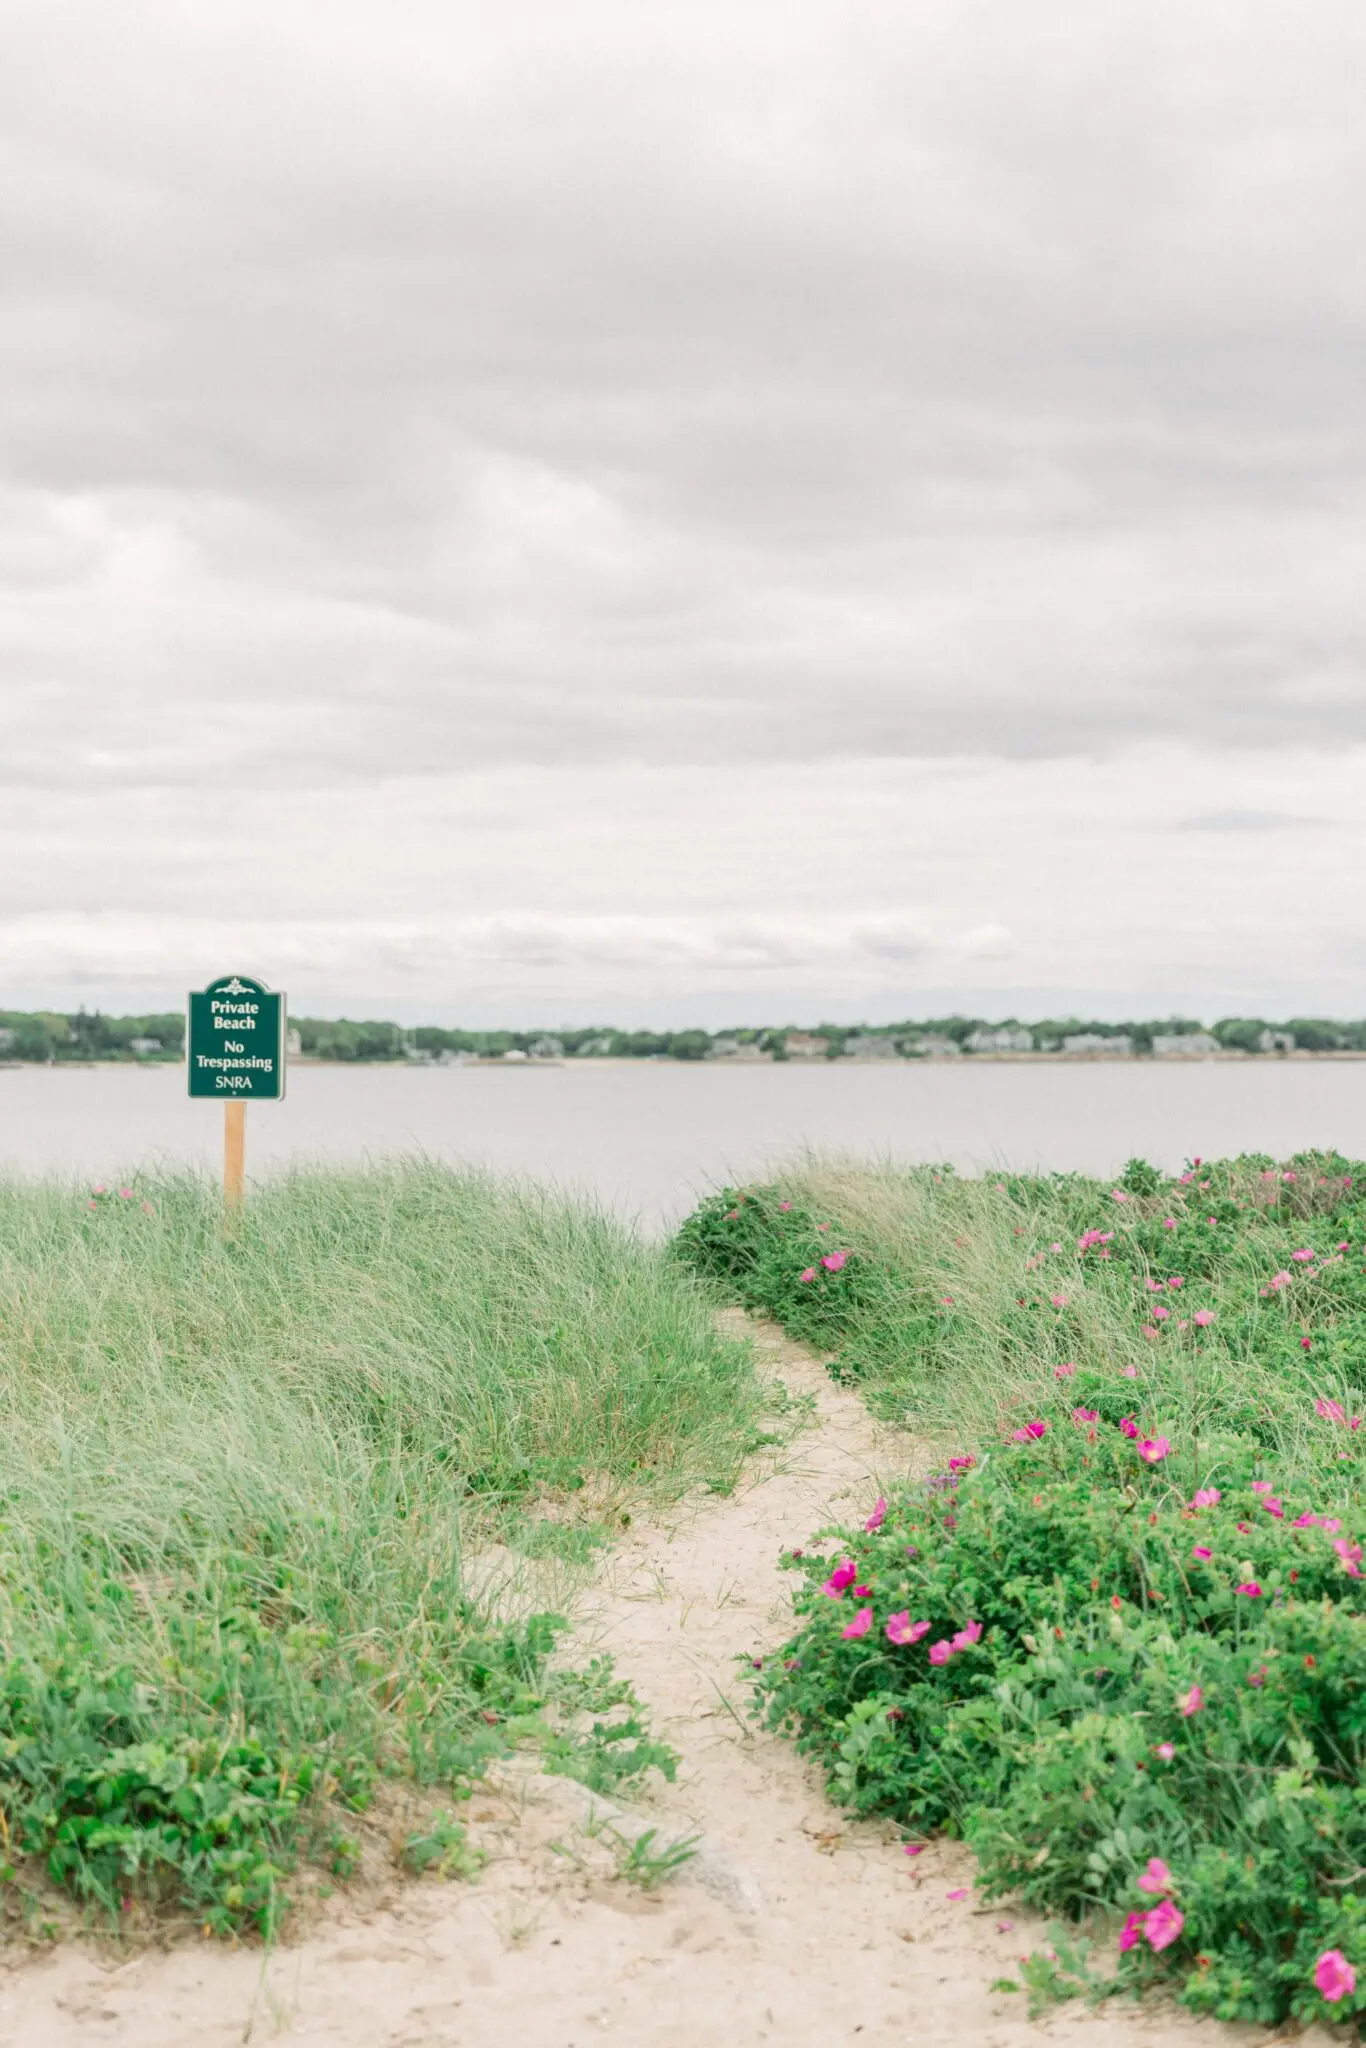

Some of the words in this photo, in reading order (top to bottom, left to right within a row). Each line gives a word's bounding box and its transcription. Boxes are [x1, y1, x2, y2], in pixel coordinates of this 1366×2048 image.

[211, 1000, 259, 1014] Private
[214, 1016, 256, 1030] Beach
[224, 1040, 245, 1053] No
[196, 1055, 273, 1072] Trespassing
[215, 1076, 252, 1088] SNRA
